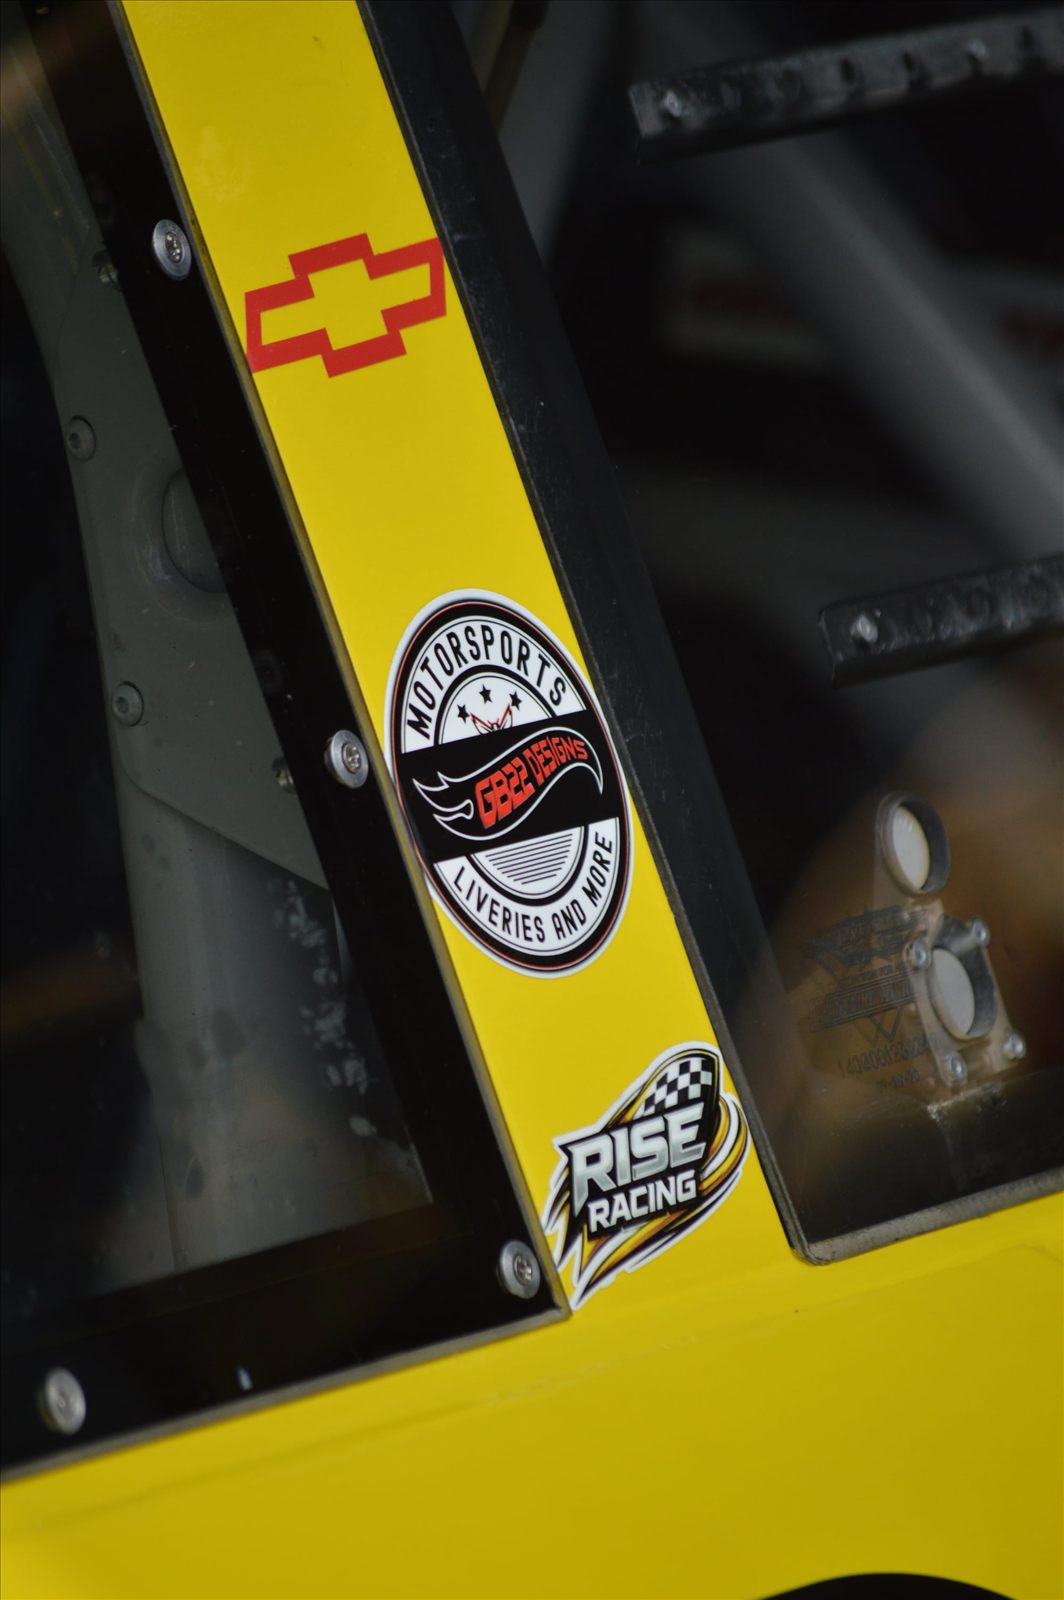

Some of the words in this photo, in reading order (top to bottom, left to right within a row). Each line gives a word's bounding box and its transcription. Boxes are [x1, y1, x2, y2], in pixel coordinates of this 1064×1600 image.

[407, 625, 566, 739] MOTORSPORTS
[474, 757, 535, 829] GB22
[523, 735, 588, 783] DESIGNS
[453, 866, 545, 943] LIVERIES
[552, 899, 587, 940] AND
[582, 832, 612, 907] MORE
[567, 1102, 706, 1218] RISE
[587, 1169, 697, 1233] RACING
